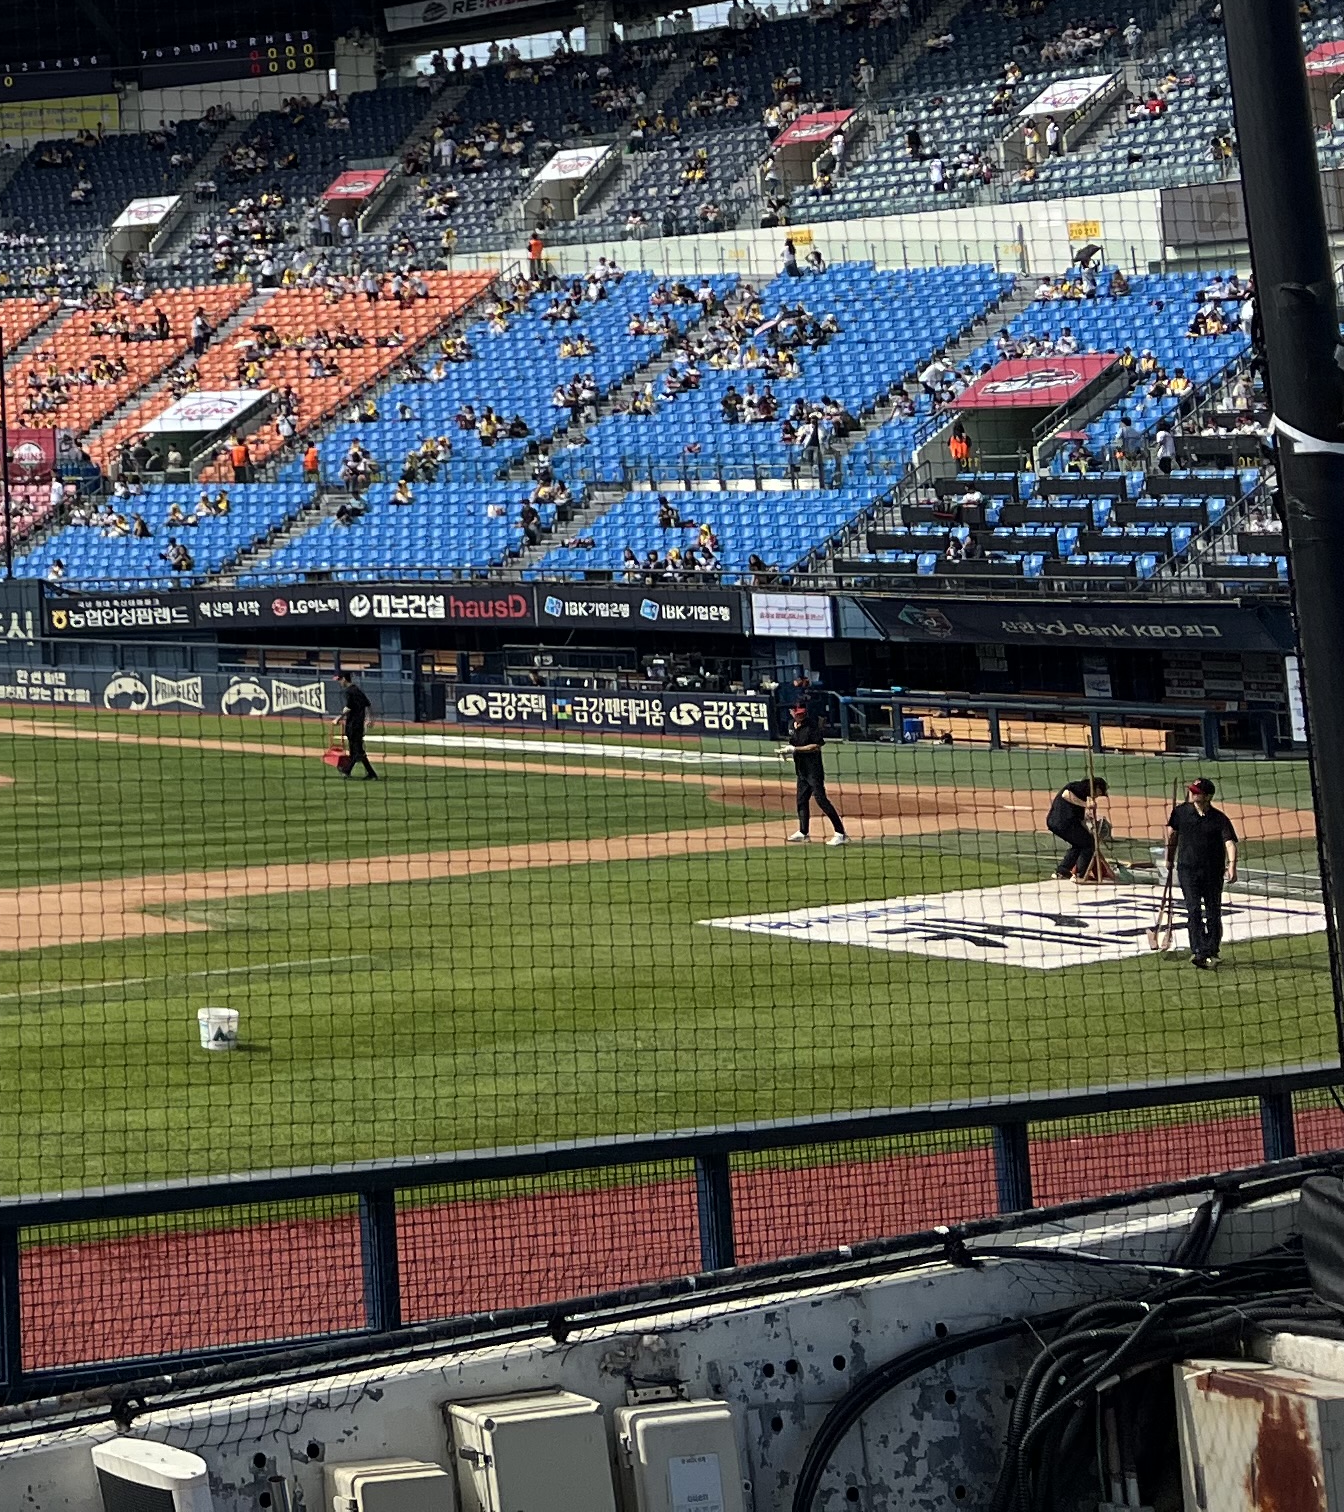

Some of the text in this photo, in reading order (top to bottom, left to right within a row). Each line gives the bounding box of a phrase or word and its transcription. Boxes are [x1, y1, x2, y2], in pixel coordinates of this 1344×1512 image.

[190, 44, 201, 53] 10
[208, 41, 218, 51] 11
[3, 76, 13, 88] 0
[268, 48, 277, 59] 0
[285, 45, 295, 57] 0
[303, 43, 313, 55] 0
[268, 61, 278, 72] 0
[286, 59, 296, 70] 0
[304, 57, 314, 68] 0
[68, 606, 190, 629] 농협안성팜랜드
[198, 600, 261, 618] 혁신의 시작
[372, 594, 446, 619] 대보건설
[154, 676, 201, 705] PRINGLES
[275, 682, 323, 711] PRINGLES
[487, 691, 547, 721] 금강주택
[572, 695, 667, 726] 금강펜테리움
[703, 700, 769, 731] 금강주택
